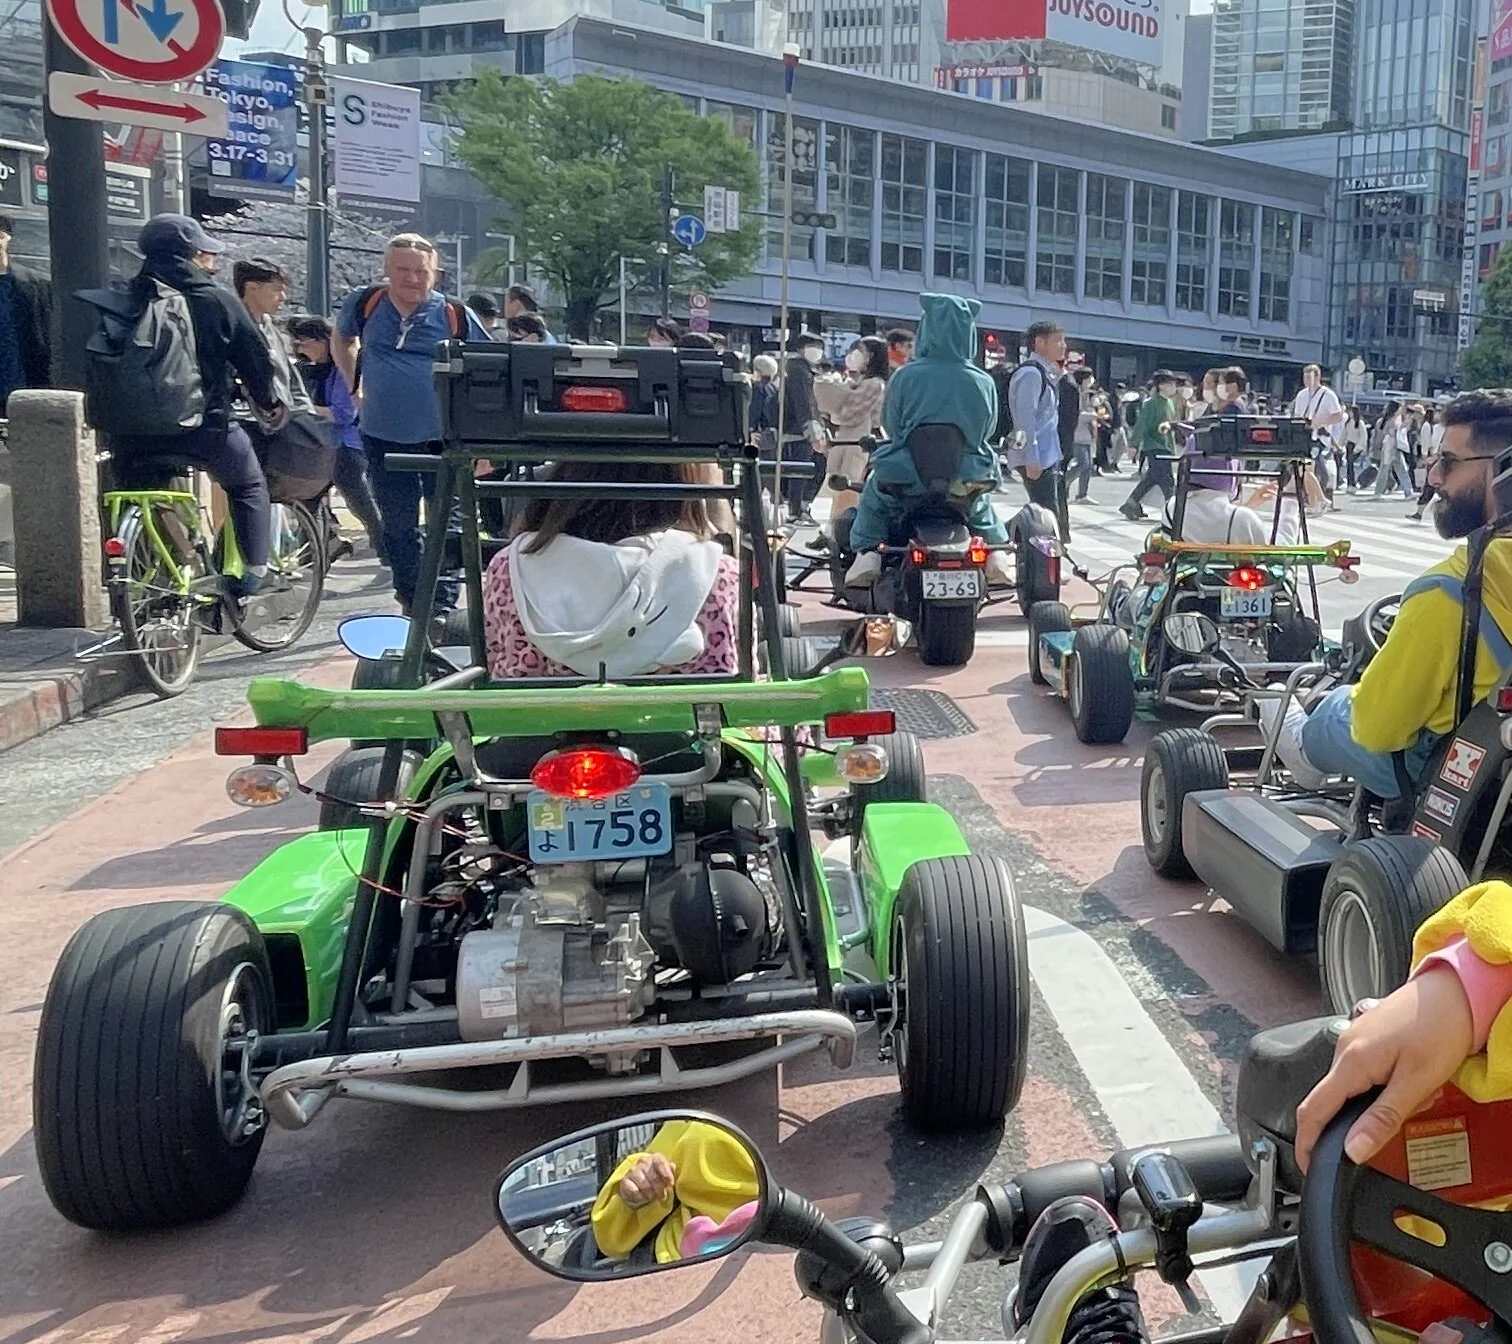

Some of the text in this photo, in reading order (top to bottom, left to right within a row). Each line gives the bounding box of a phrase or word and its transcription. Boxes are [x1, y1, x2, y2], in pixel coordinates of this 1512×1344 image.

[206, 68, 293, 97] Fashion,
[228, 110, 284, 131] sign,
[226, 129, 271, 146] eace
[209, 142, 294, 167] 3.17-3.31
[1344, 174, 1427, 190] MARK CITY
[926, 582, 977, 597] 23-69
[1234, 598, 1266, 613] 1361
[538, 809, 663, 853] よ 1758
